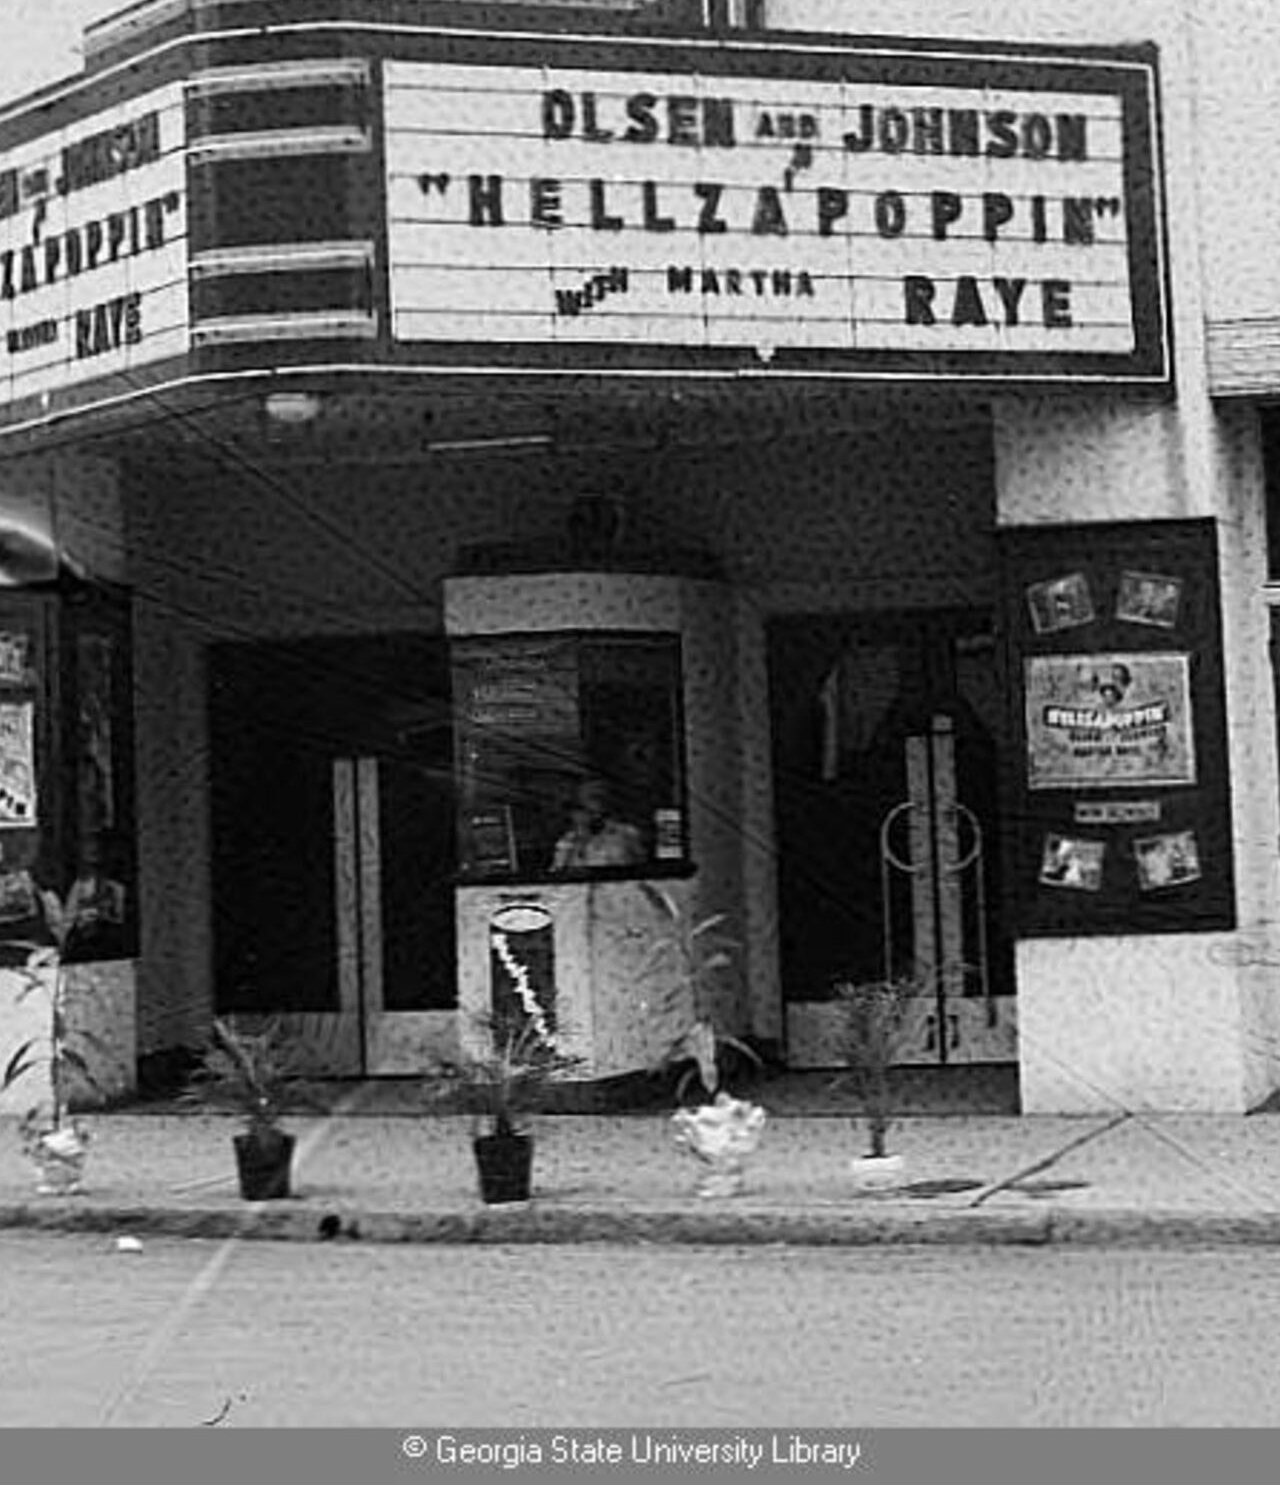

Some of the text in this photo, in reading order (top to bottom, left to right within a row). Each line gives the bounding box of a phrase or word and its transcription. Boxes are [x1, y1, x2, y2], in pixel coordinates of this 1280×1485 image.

[543, 89, 1087, 162] OLSEN AND JOHNSON
[76, 292, 143, 360] RAYE
[556, 266, 1072, 329] WITH MARTHA RAYE
